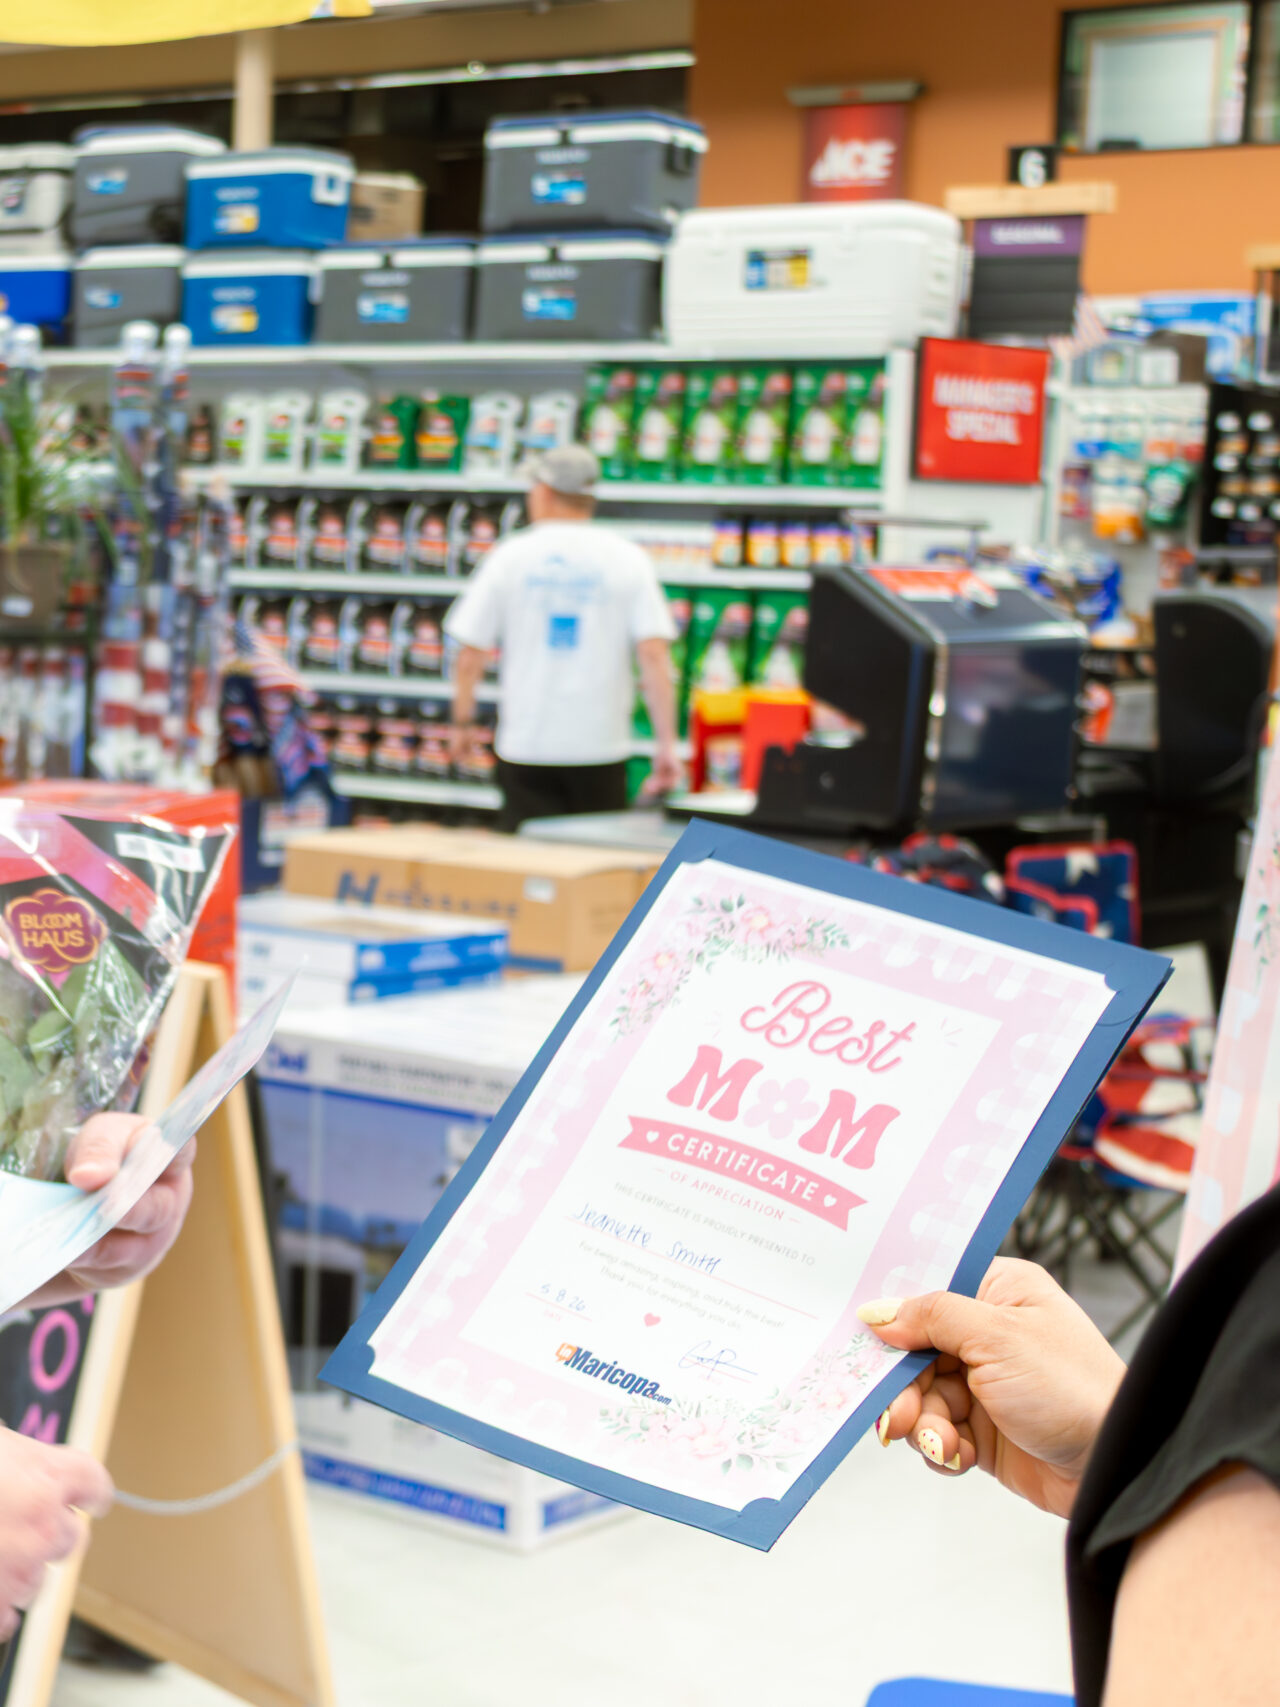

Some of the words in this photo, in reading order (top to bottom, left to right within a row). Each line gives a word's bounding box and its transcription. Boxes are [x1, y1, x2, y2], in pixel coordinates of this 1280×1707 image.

[809, 135, 897, 188] ACE
[1018, 149, 1047, 188] 6
[946, 408, 1021, 445] SPECIAL
[19, 912, 83, 930] BLOOM
[22, 929, 86, 949] HAUS
[740, 980, 917, 1073] Best
[667, 1133, 819, 1202] CERTIFICATE
[670, 1170, 689, 1184] OF
[691, 1177, 785, 1221] APPRECIATION
[634, 1190, 692, 1219] CERTIFICATE
[747, 1233, 799, 1261] PRESENTED
[801, 1252, 816, 1267] TO
